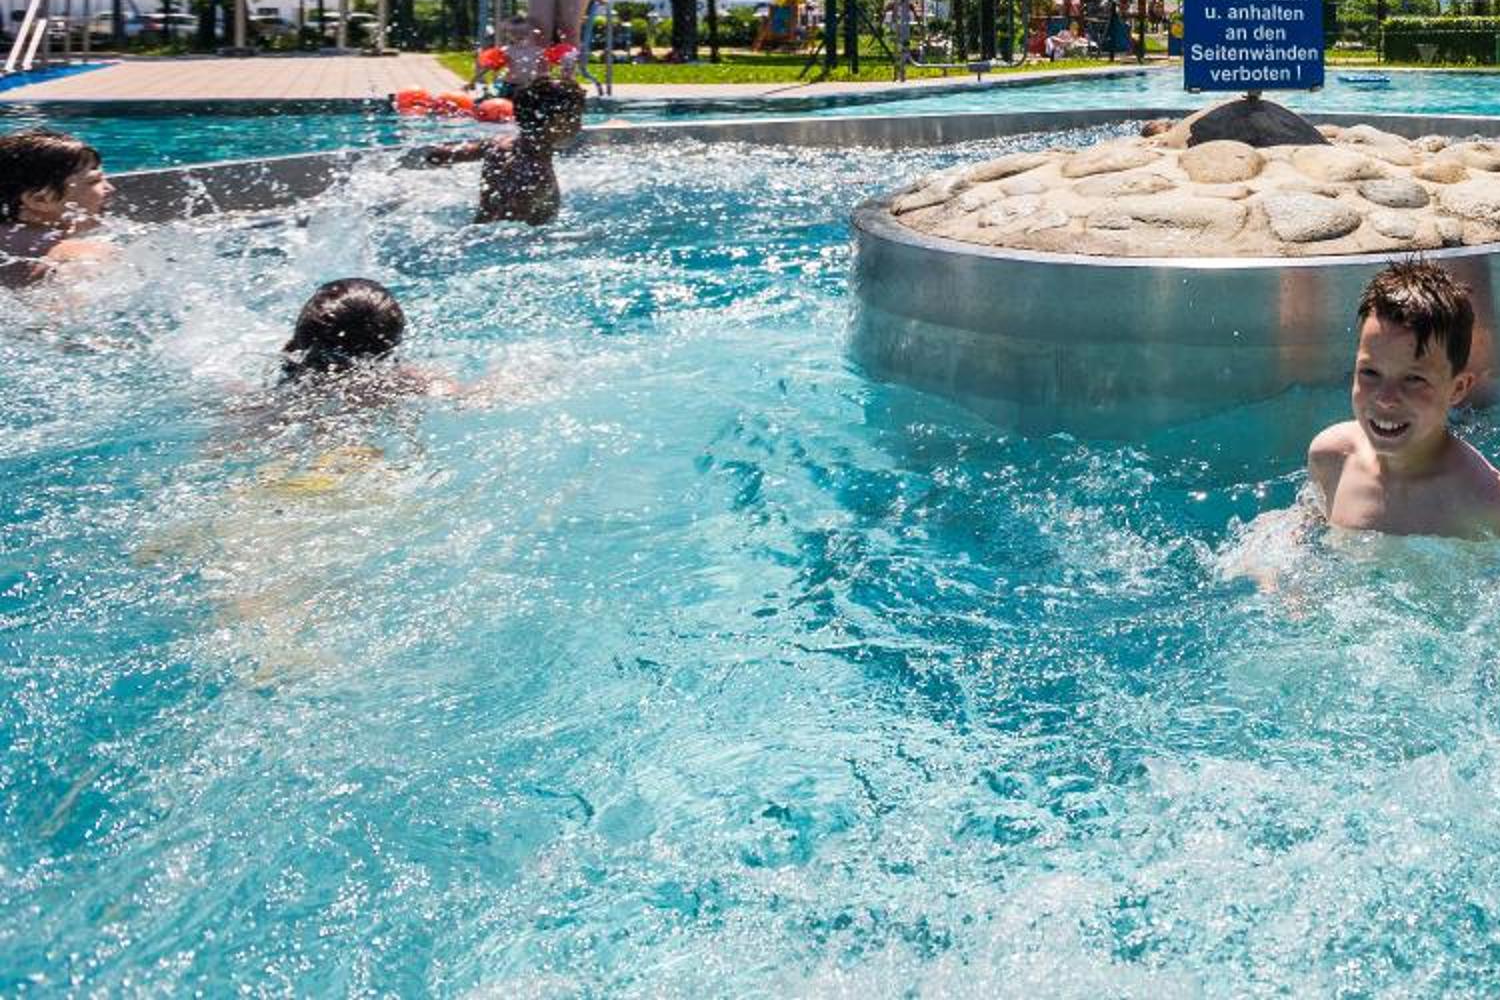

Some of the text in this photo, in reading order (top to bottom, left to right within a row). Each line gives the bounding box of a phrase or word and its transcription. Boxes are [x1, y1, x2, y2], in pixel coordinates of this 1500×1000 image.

[1205, 5, 1305, 21] u. anhalten
[1225, 25, 1287, 41] an den
[1191, 44, 1319, 62] Seitenwänden
[1210, 65, 1291, 81] verboten
